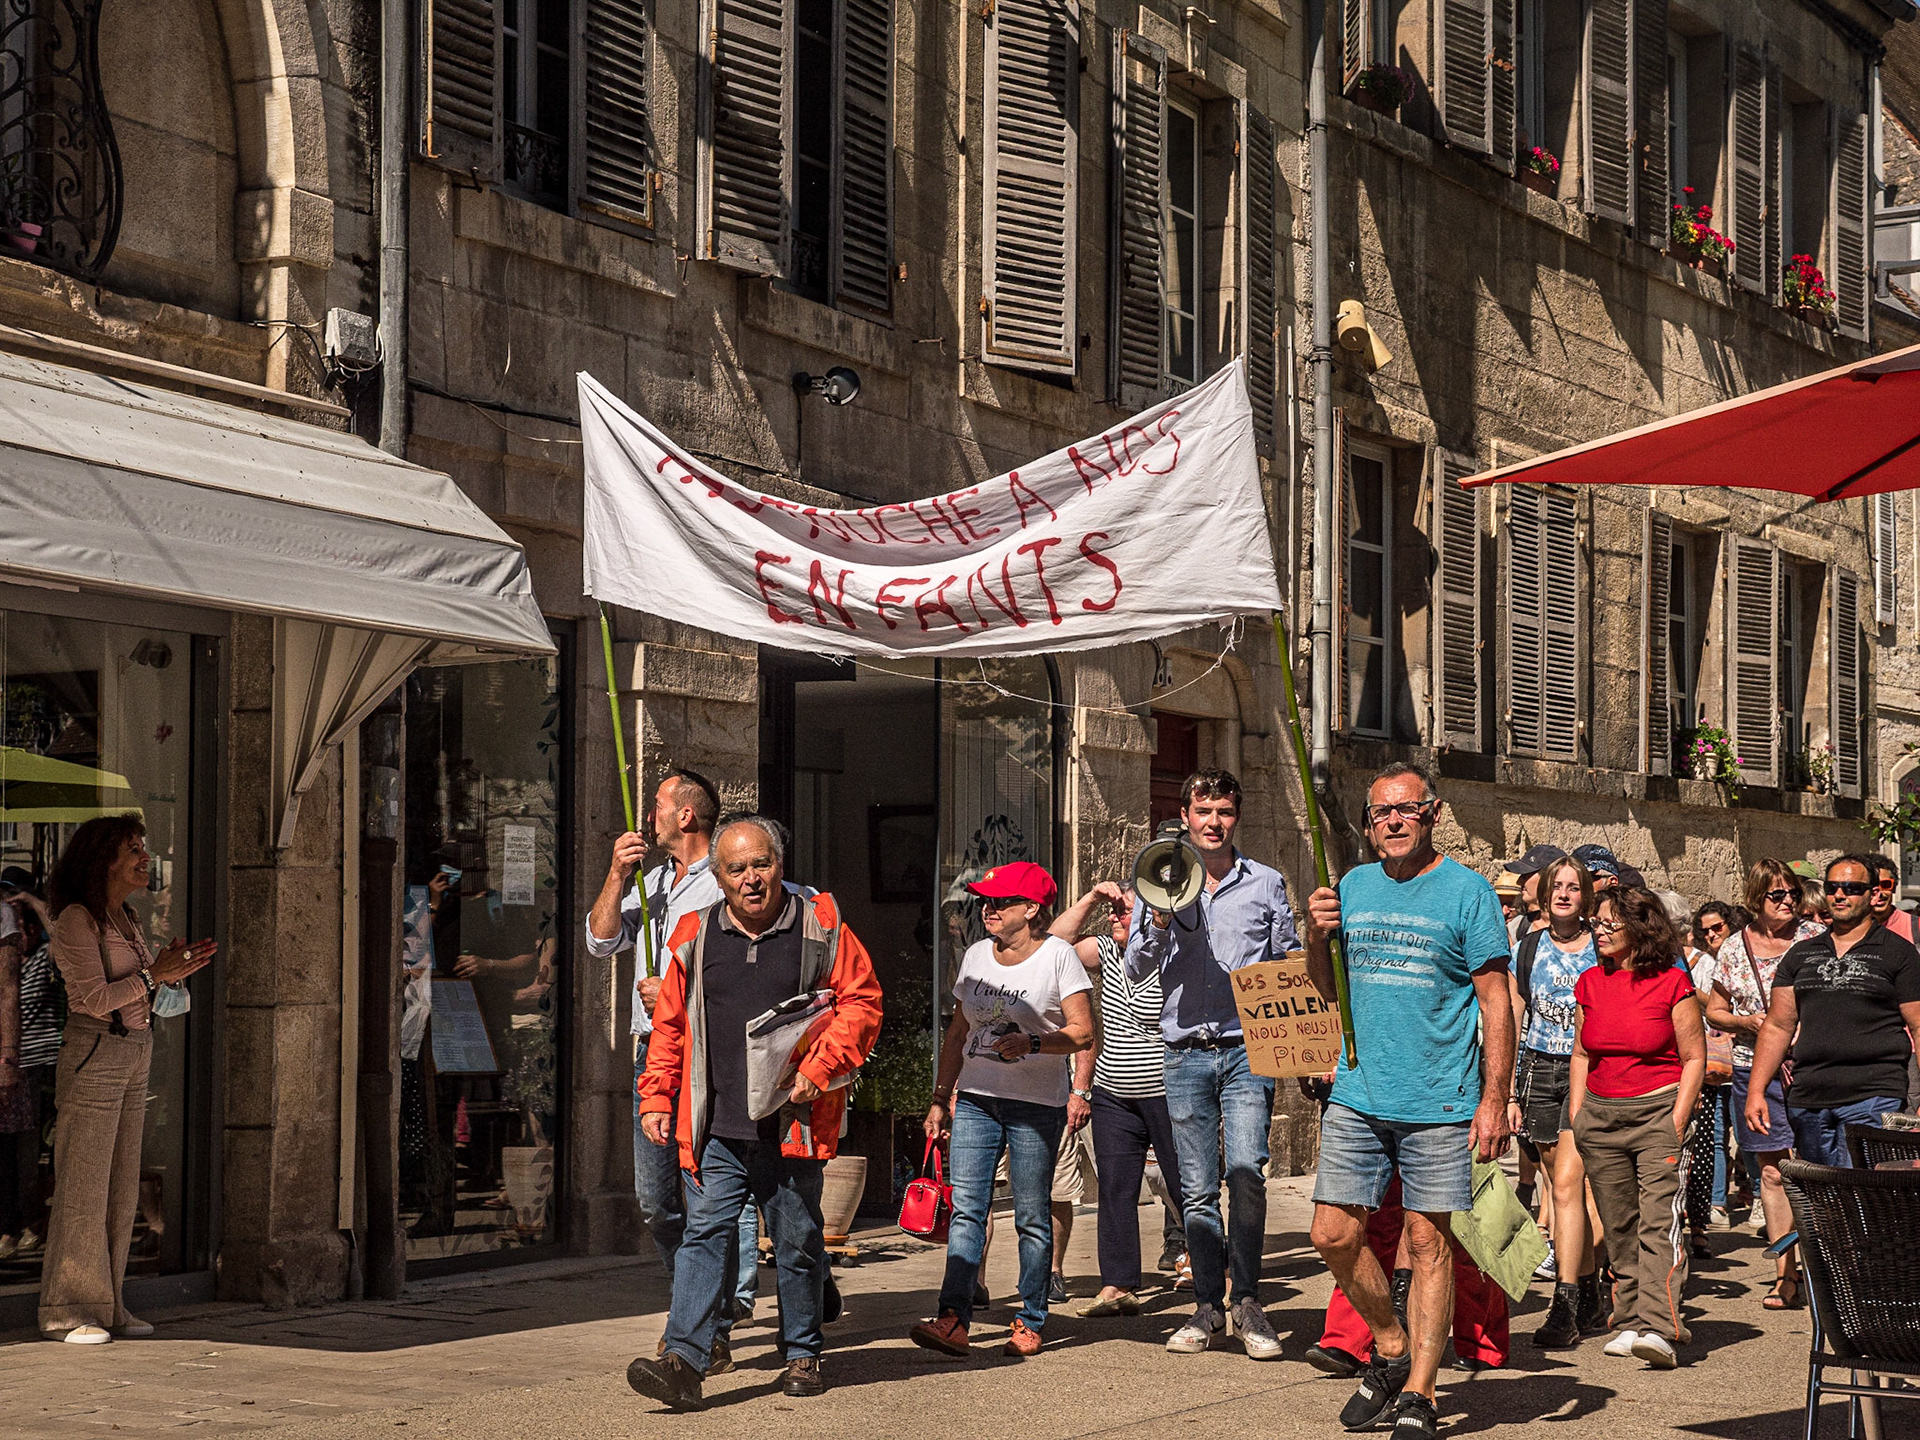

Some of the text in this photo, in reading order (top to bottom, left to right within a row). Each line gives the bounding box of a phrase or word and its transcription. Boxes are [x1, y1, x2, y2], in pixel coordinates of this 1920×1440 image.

[1346, 929, 1434, 952] UTHENTIQUE
[1353, 947, 1412, 974] Original
[1277, 971, 1314, 990] SOR
[1553, 975, 1579, 987] GOO
[974, 978, 1029, 1005] Vintage
[1249, 1023, 1288, 1041] NOUS
[1547, 1040, 1572, 1053] LUC
[1396, 1417, 1423, 1428] PUMA
